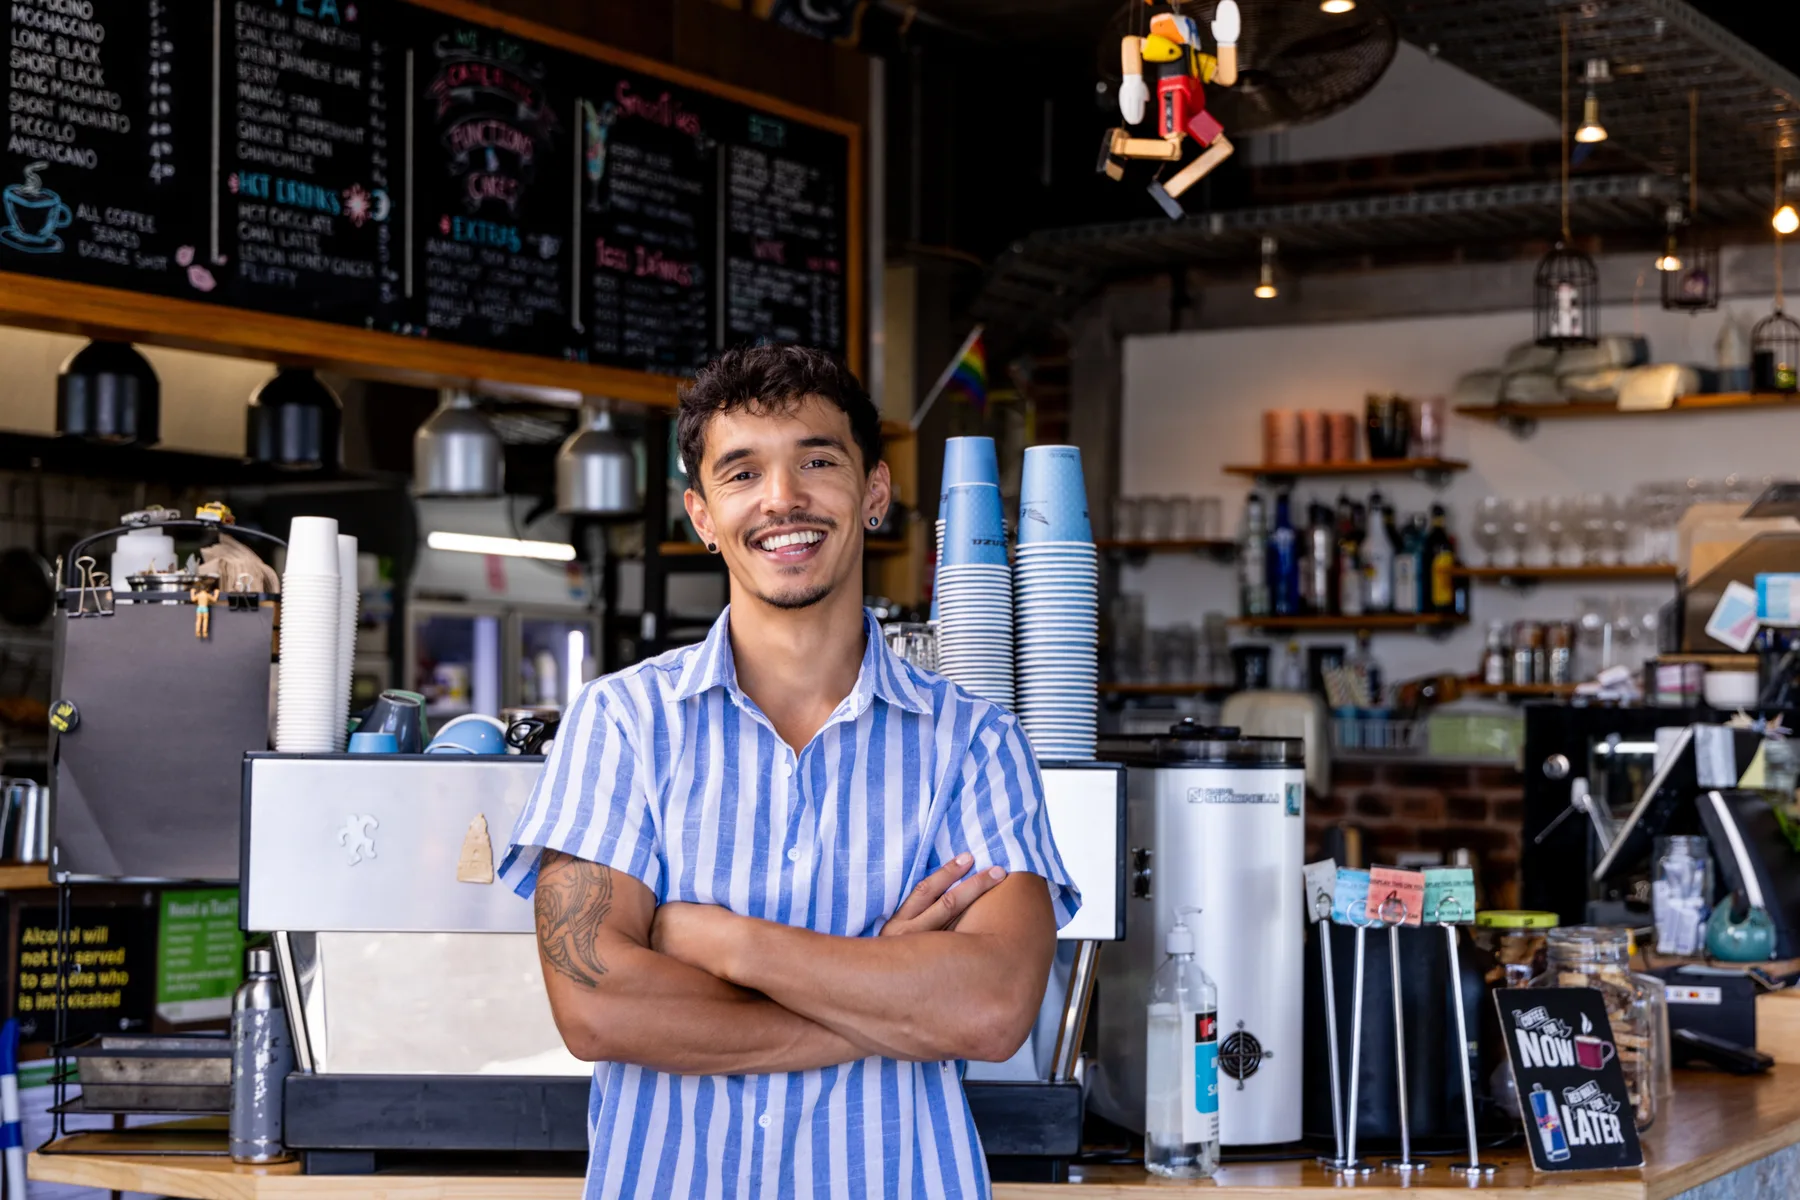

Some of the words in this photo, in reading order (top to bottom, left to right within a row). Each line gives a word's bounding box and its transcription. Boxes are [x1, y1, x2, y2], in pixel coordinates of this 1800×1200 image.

[10, 26, 52, 54] LONG
[54, 35, 101, 65] BLACK
[9, 47, 58, 76] SHORT
[60, 59, 105, 87] BLACK
[10, 69, 48, 95] LONG
[8, 90, 56, 117] SHORT
[10, 112, 76, 143] PICCOLO
[7, 133, 98, 169] AMERICANO
[76, 202, 102, 223] ALL
[82, 926, 109, 944] will
[20, 949, 49, 967] not
[73, 946, 126, 965] served
[20, 972, 39, 989] to
[97, 969, 129, 986] who
[18, 992, 34, 1011] is
[1519, 1007, 1547, 1027] COFFEE
[1543, 1022, 1559, 1035] FOR
[1515, 1028, 1576, 1068] NOW
[1560, 1104, 1625, 1146] LATER
